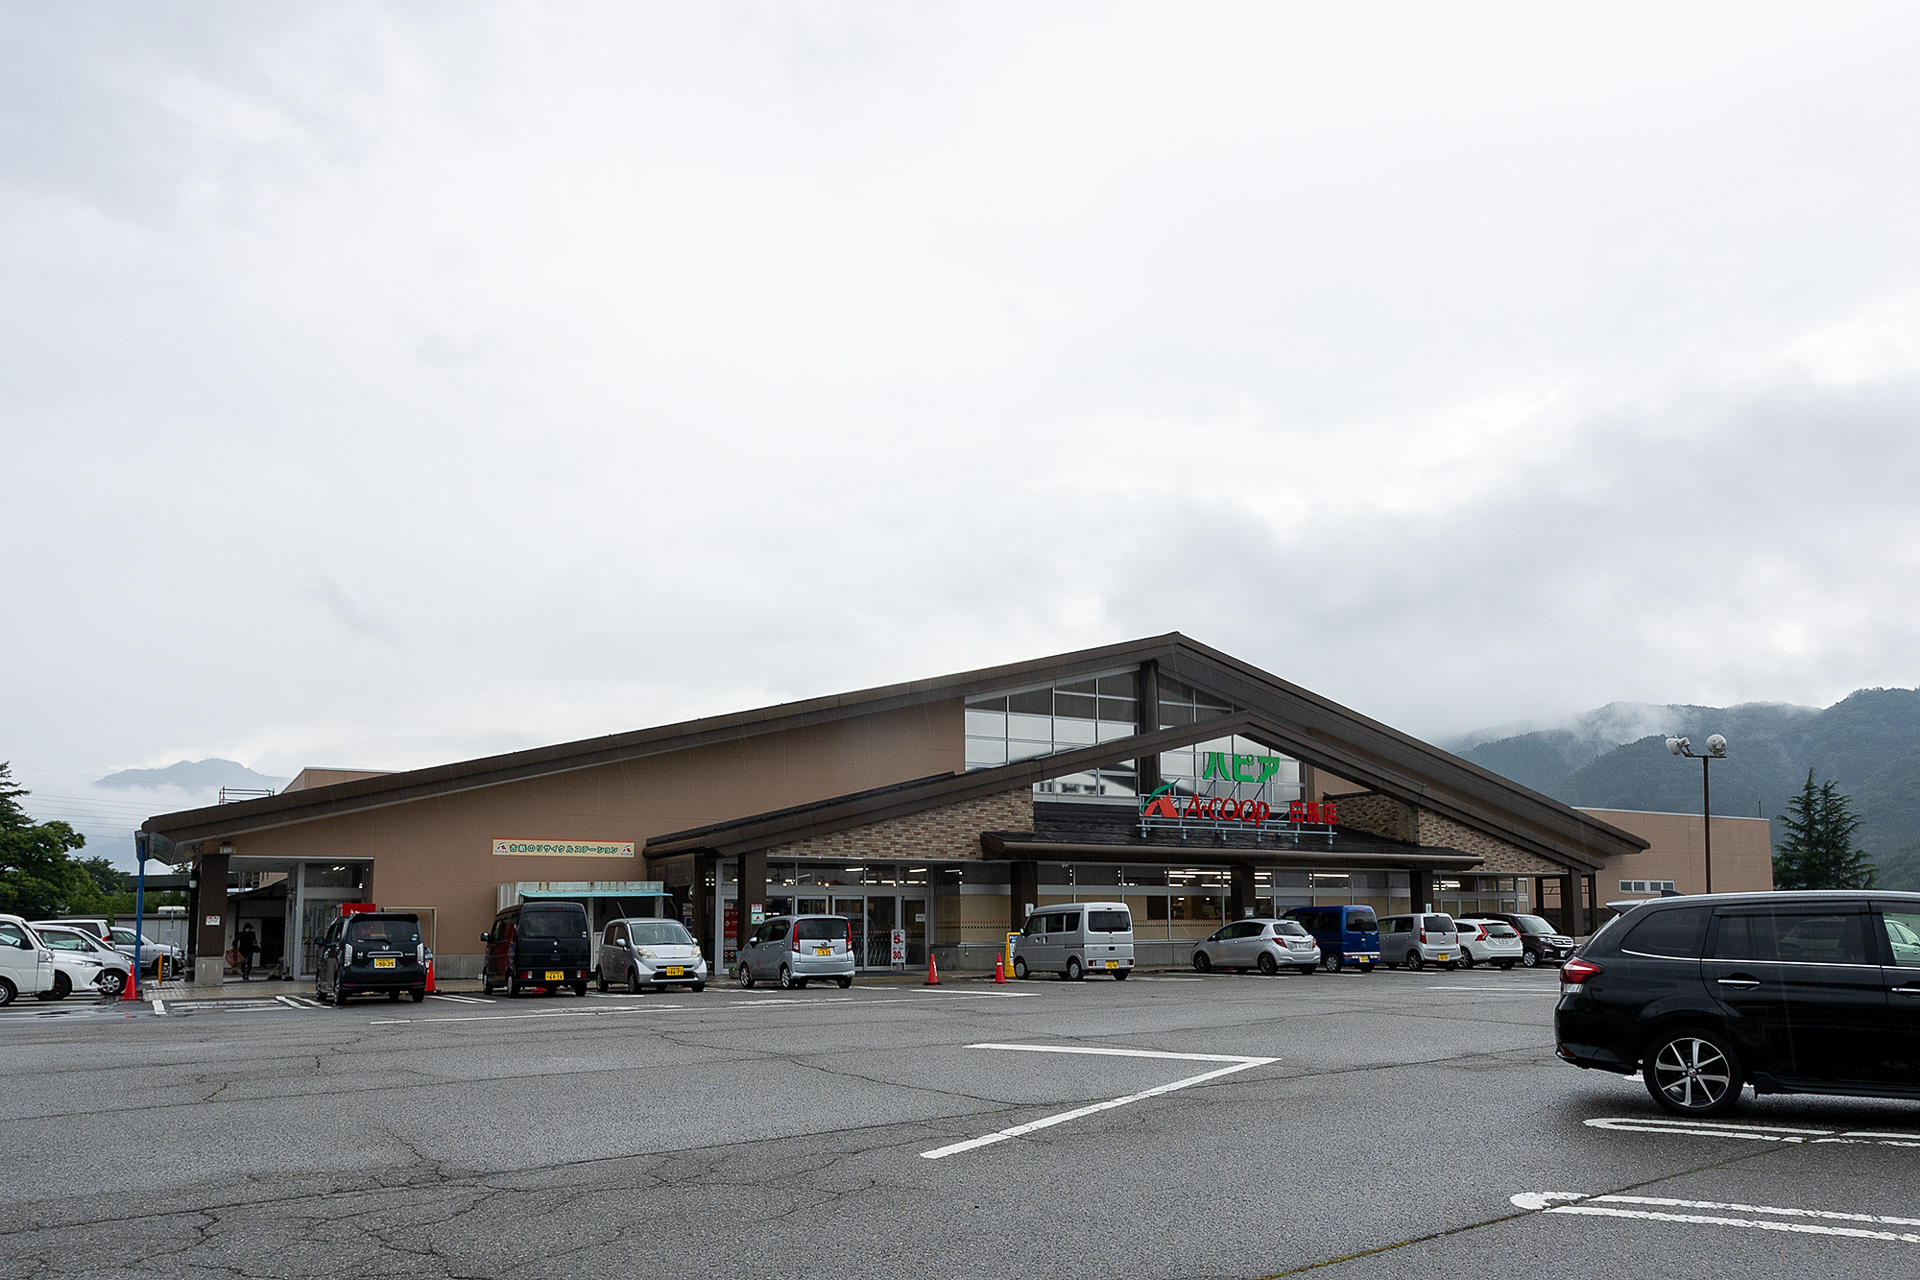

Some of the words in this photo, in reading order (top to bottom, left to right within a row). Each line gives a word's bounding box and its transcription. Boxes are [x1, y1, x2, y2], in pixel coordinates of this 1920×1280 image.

[1203, 752, 1280, 782] ハピア
[1290, 801, 1337, 825] 白馬店
[509, 844, 618, 854] 古紙のリサイクルステーション
